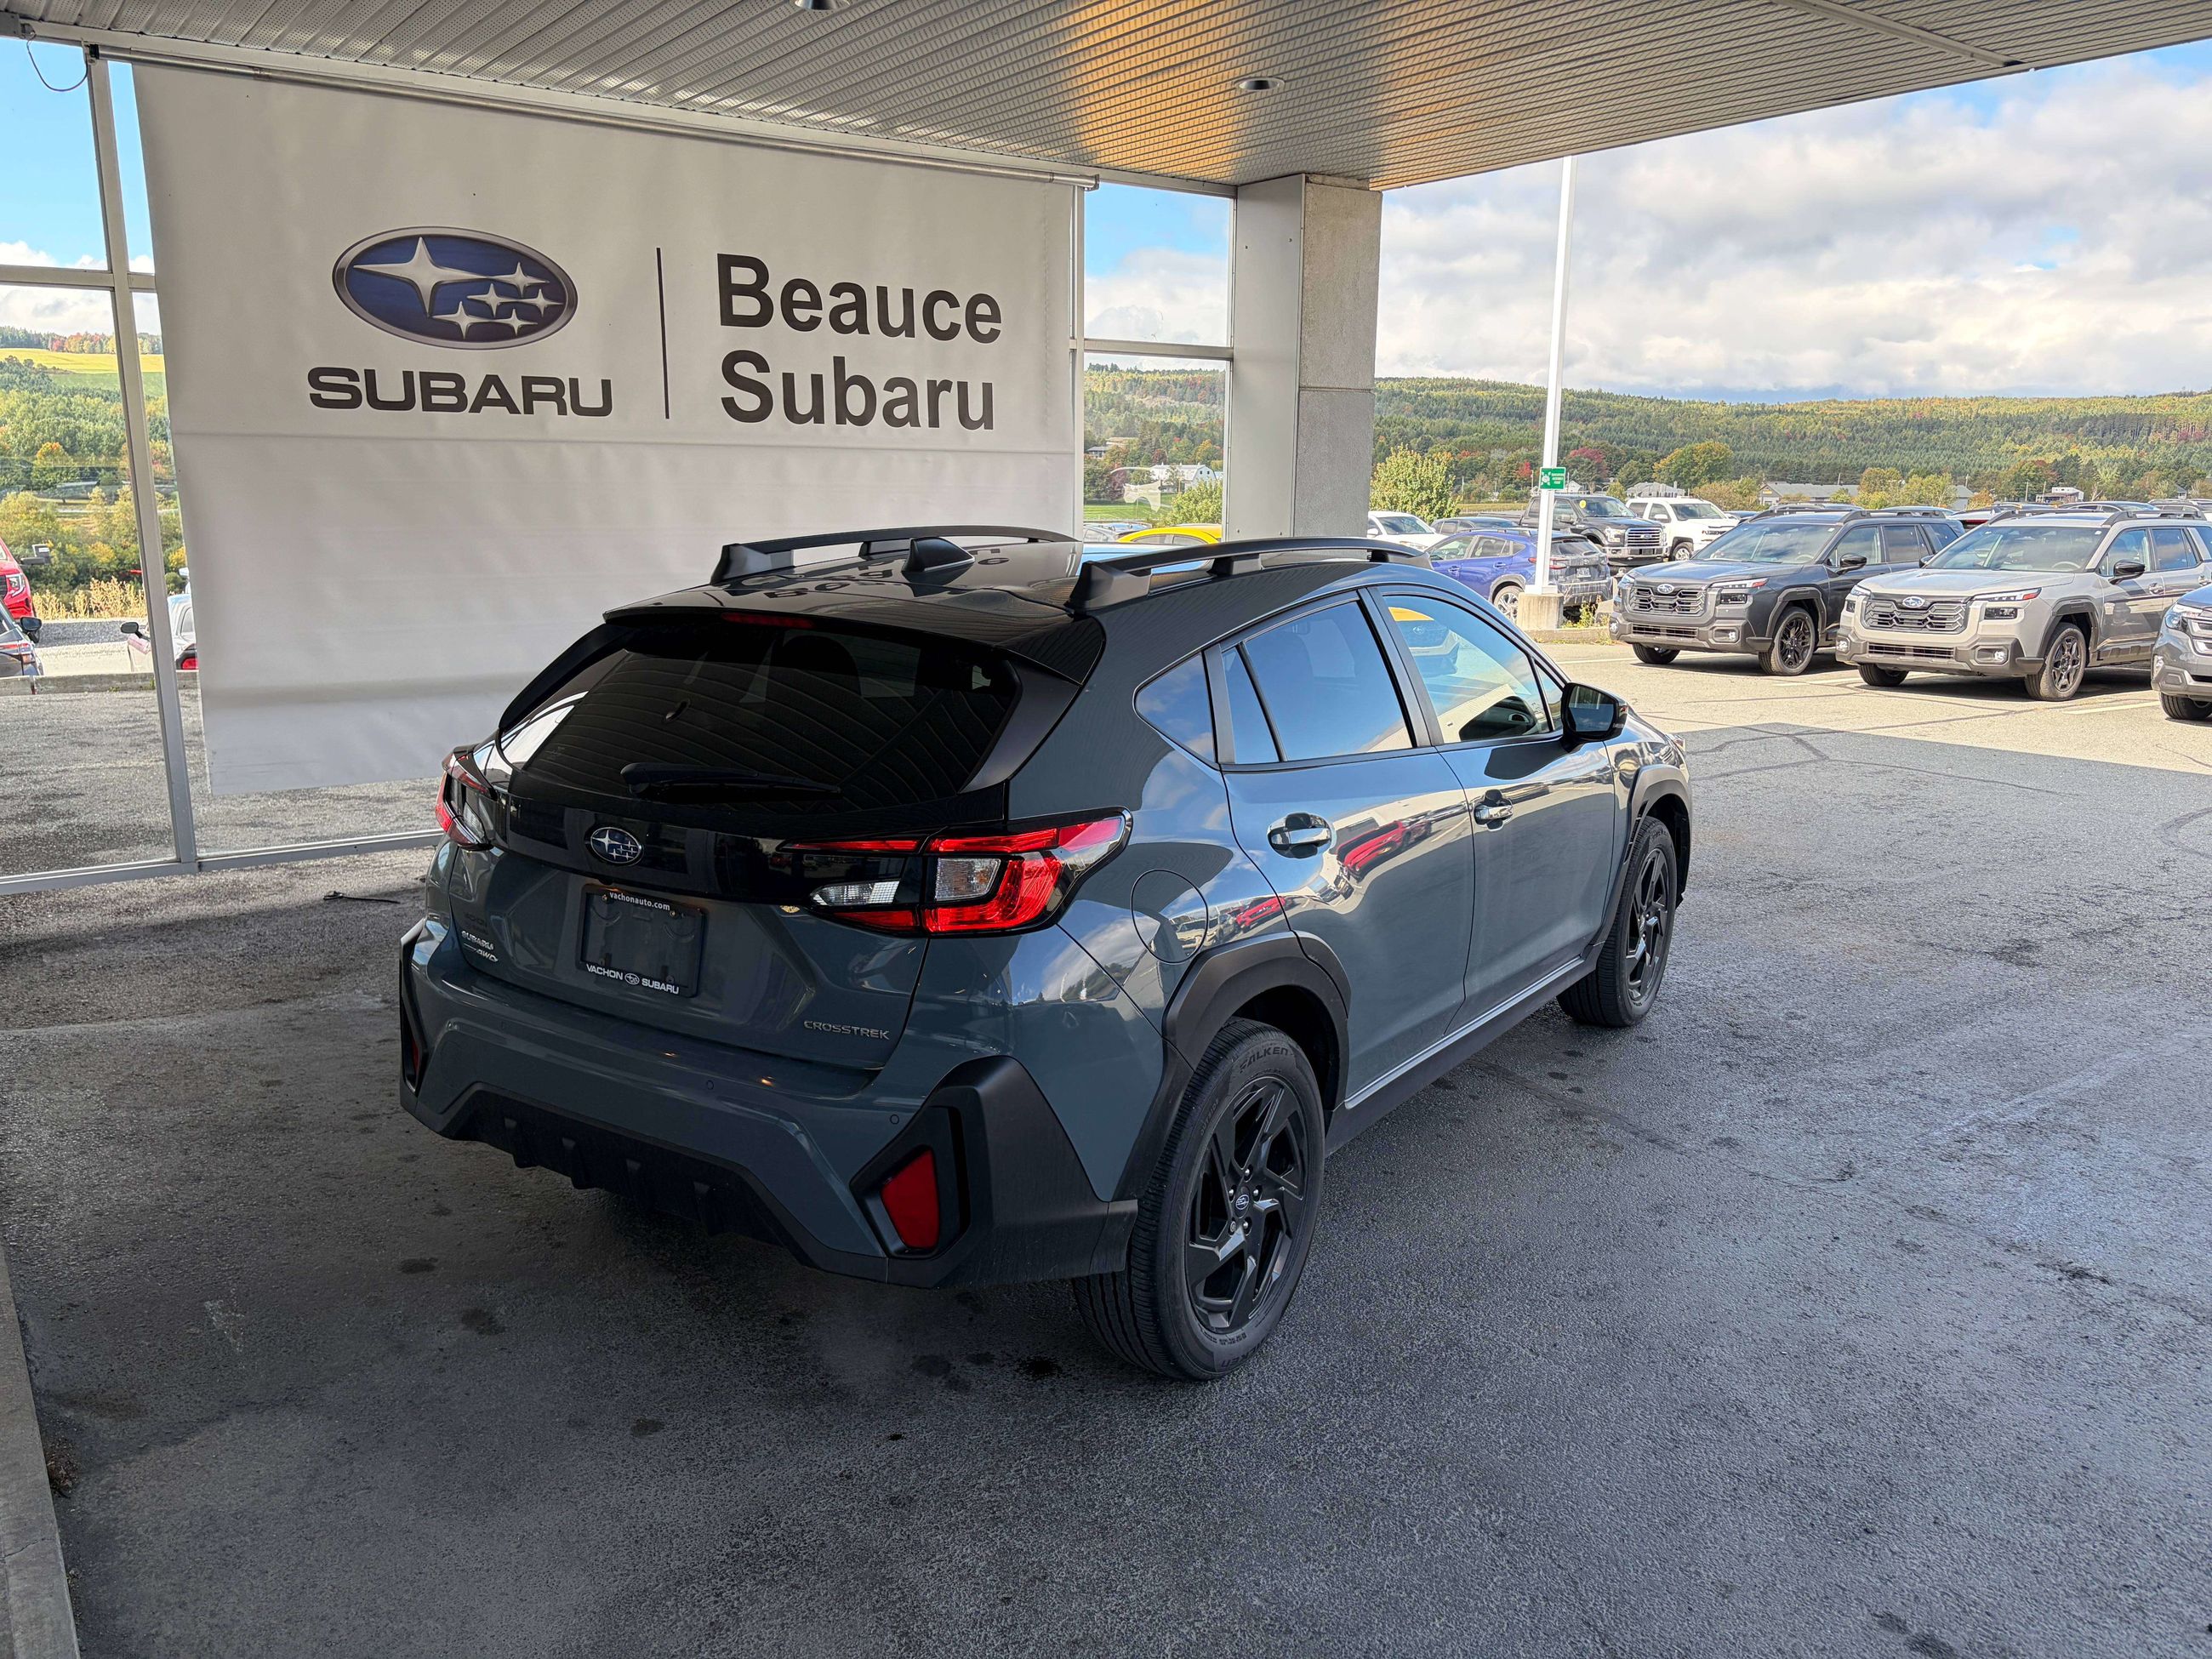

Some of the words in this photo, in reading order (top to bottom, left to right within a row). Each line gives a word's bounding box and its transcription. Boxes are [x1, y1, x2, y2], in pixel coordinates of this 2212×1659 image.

[716, 253, 1003, 343] Beauce
[308, 367, 613, 417] SUBARU
[721, 350, 995, 430] Subaru
[609, 892, 670, 911] vachonauto.com
[461, 930, 494, 950] SUBARU
[586, 963, 624, 980] VACHON
[641, 978, 680, 995] SUBARU
[803, 1020, 890, 1040] CROSSTREK
[1239, 1046, 1289, 1074] FALKEN
